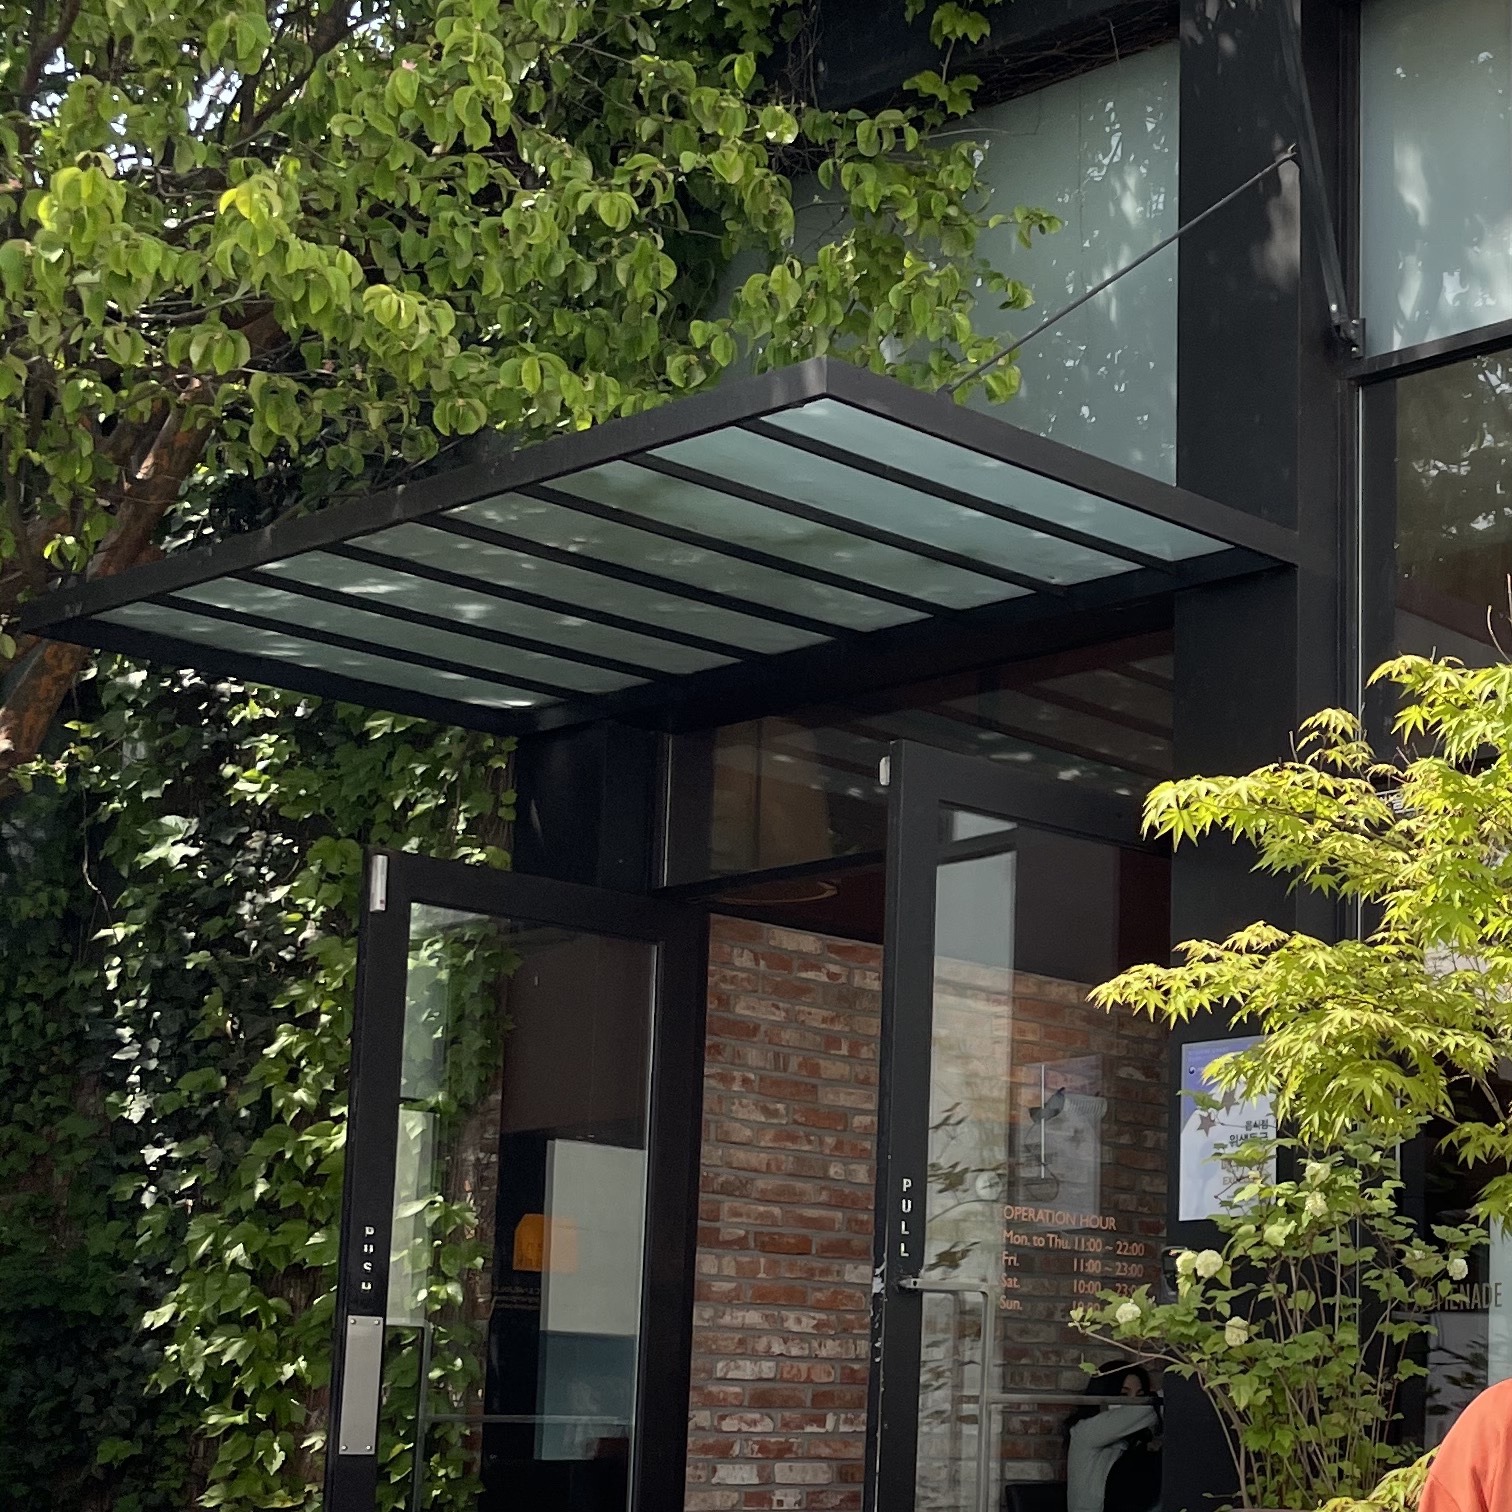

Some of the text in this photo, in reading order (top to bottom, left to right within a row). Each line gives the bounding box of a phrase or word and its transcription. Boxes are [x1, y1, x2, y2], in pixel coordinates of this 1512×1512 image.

[900, 1178, 912, 1257] PULL
[1003, 1205, 1117, 1231] OPERATION HOUR
[1002, 1230, 1030, 1246] Mon.
[1033, 1236, 1045, 1248] to
[1074, 1237, 1102, 1252] 11:00
[1116, 1241, 1145, 1256] 22:00
[1002, 1251, 1020, 1267] Fri.
[1073, 1258, 1101, 1273] 11:00
[1115, 1262, 1144, 1277] 23:00
[1000, 1295, 1022, 1311] Sun.
